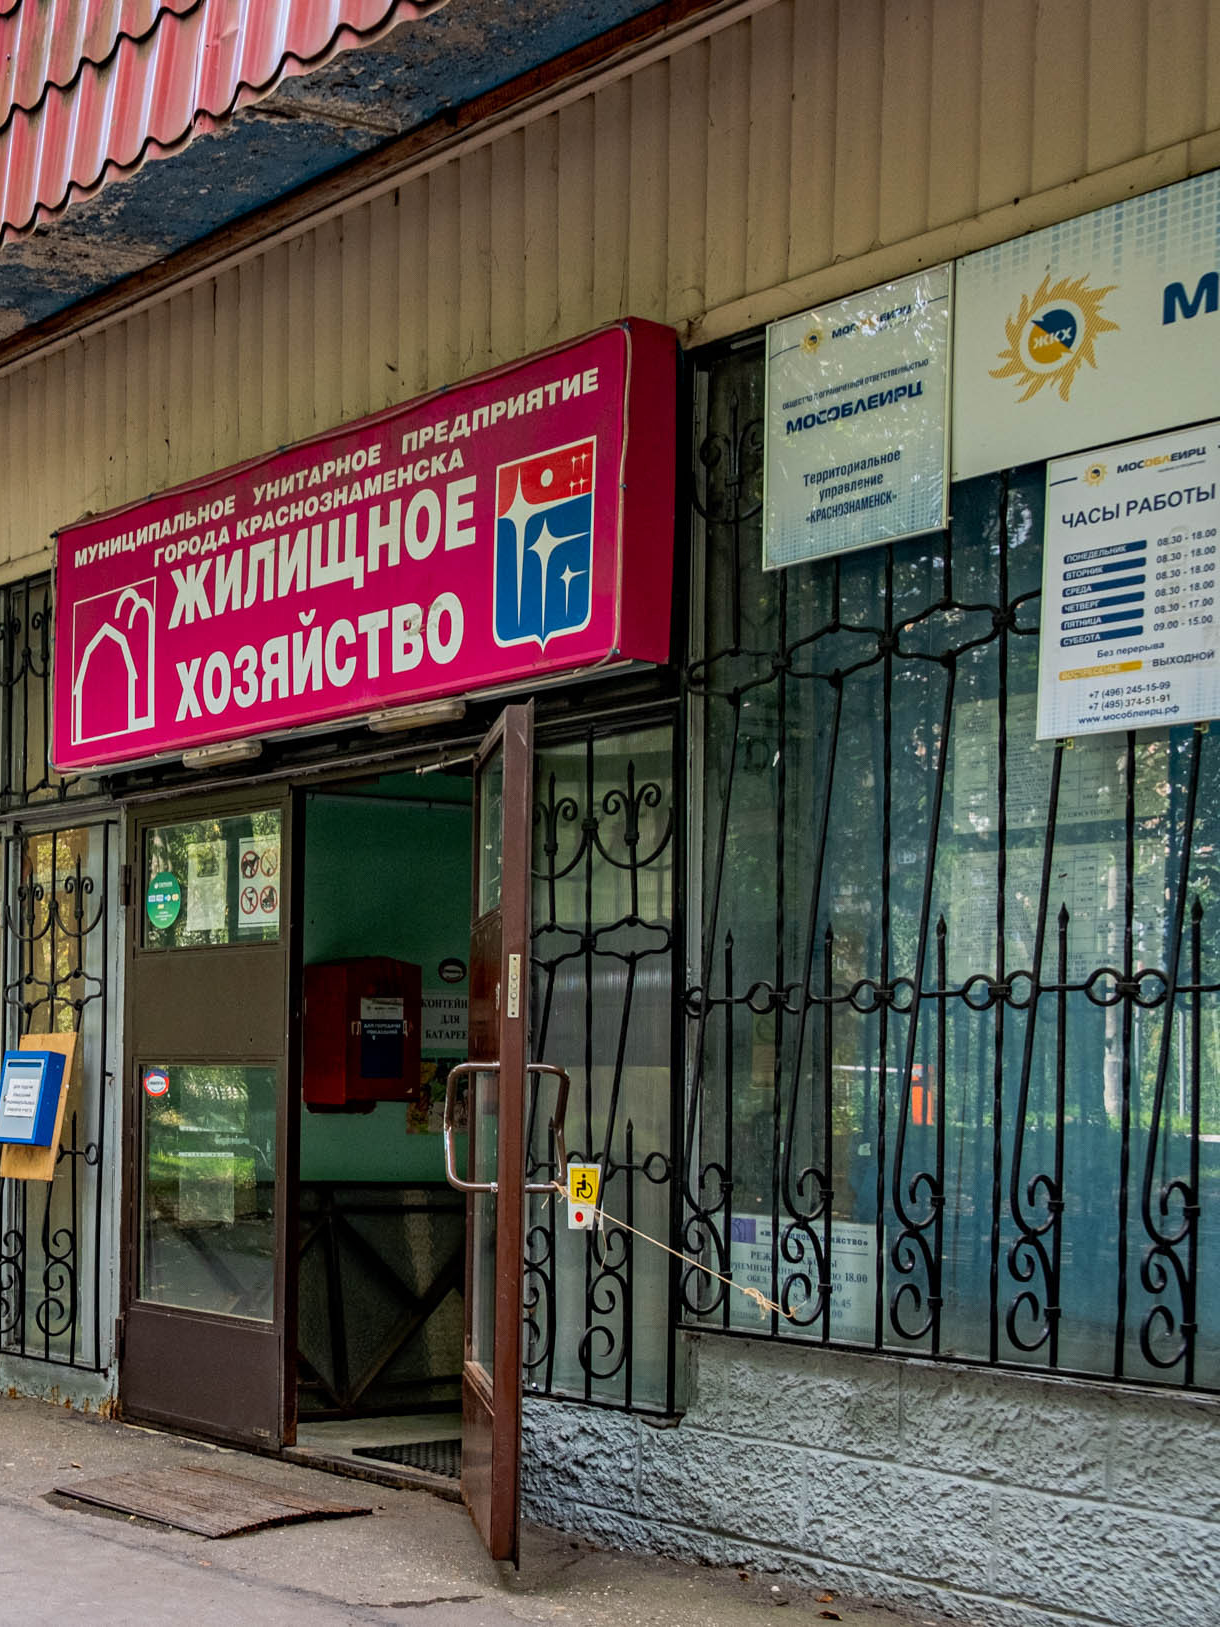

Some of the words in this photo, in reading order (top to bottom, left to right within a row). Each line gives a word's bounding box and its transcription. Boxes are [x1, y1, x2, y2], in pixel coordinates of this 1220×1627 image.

[1033, 327, 1073, 350] ЖКХ
[786, 380, 924, 435] МОСОБЛЕИРЦ
[74, 494, 236, 569] МУНИЦИПАЛЬНОЕ
[253, 443, 382, 504] УНИТАРНОЕ
[401, 367, 599, 453] ПРЕДПРИЯТИЕ
[803, 450, 901, 487] Территориальное
[1117, 446, 1206, 474] МОСОБЛЕИРЦ
[819, 473, 884, 502] управление
[153, 528, 231, 568] ГОРОДА
[235, 448, 465, 538] КРАСНОЗНАМЕНСКА
[1062, 503, 1120, 528] ЧАСЫ
[1126, 484, 1216, 516] РАБОТЫ
[167, 475, 477, 630] ЖИЛИЩНОЕ
[1066, 545, 1127, 563] ПОНЕДЕЛЬНИК
[1157, 534, 1182, 547] 08.30
[1191, 528, 1217, 541] 18.00
[1065, 566, 1103, 580] ВТОРНИК
[1156, 551, 1181, 564] 08.30
[1191, 545, 1216, 558] 18.00
[1064, 600, 1099, 613] ЧЕТВЕРГ
[1155, 586, 1180, 598] 08.30
[1189, 580, 1215, 592] 18.00
[1065, 585, 1092, 597] СРЕДА
[1155, 569, 1181, 581] 08.30
[1190, 563, 1216, 575] 18.00
[1063, 616, 1102, 630] ПЯТНИЦА
[1154, 602, 1180, 615] 08.30
[1189, 597, 1214, 609] 17.00
[1063, 633, 1101, 646] СУББОТА
[1153, 620, 1179, 632] 09.00
[1188, 614, 1213, 626] 15.00
[175, 591, 465, 723] ХОЗЯЙСТВО
[1097, 649, 1114, 658] Без
[1116, 642, 1165, 657] перерыва
[1152, 650, 1215, 667] ВЫХОДНОЙ
[1089, 690, 1099, 699] +7
[1101, 687, 1124, 699] (496)
[1126, 681, 1171, 695] 245-15-99
[1089, 702, 1099, 711] +7
[1101, 699, 1124, 711] (495)
[1125, 694, 1171, 707] 374-51-91
[1078, 705, 1180, 724] www.мособлеирц.рф
[441, 1015, 460, 1024] ДЛЯ
[845, 1272, 868, 1284] 18.00
